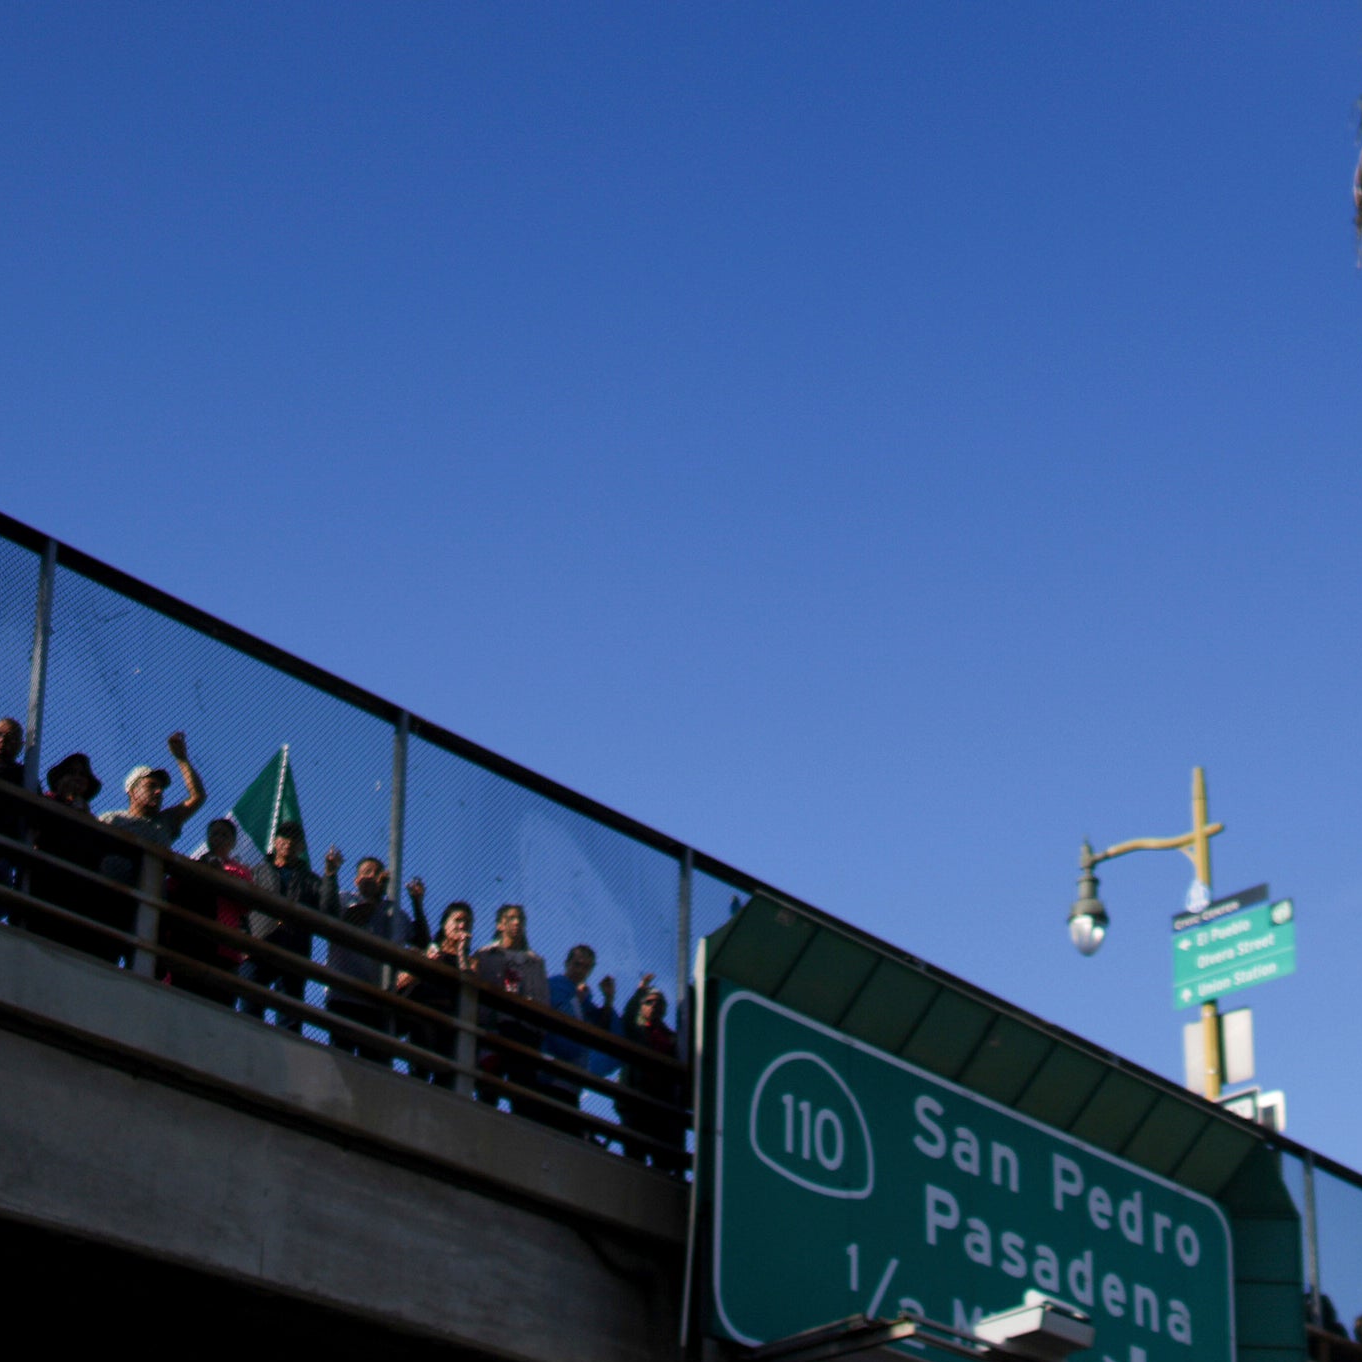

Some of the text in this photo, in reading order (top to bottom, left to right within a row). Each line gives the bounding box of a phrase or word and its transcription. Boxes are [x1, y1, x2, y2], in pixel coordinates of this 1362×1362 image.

[1197, 919, 1251, 947] El Pueblo
[1197, 932, 1276, 969] Olvera Street
[1198, 963, 1277, 997] Union Station
[781, 1094, 845, 1171] 110
[912, 1094, 1201, 1268] San Pedro
[925, 1183, 1193, 1346] Pasadena
